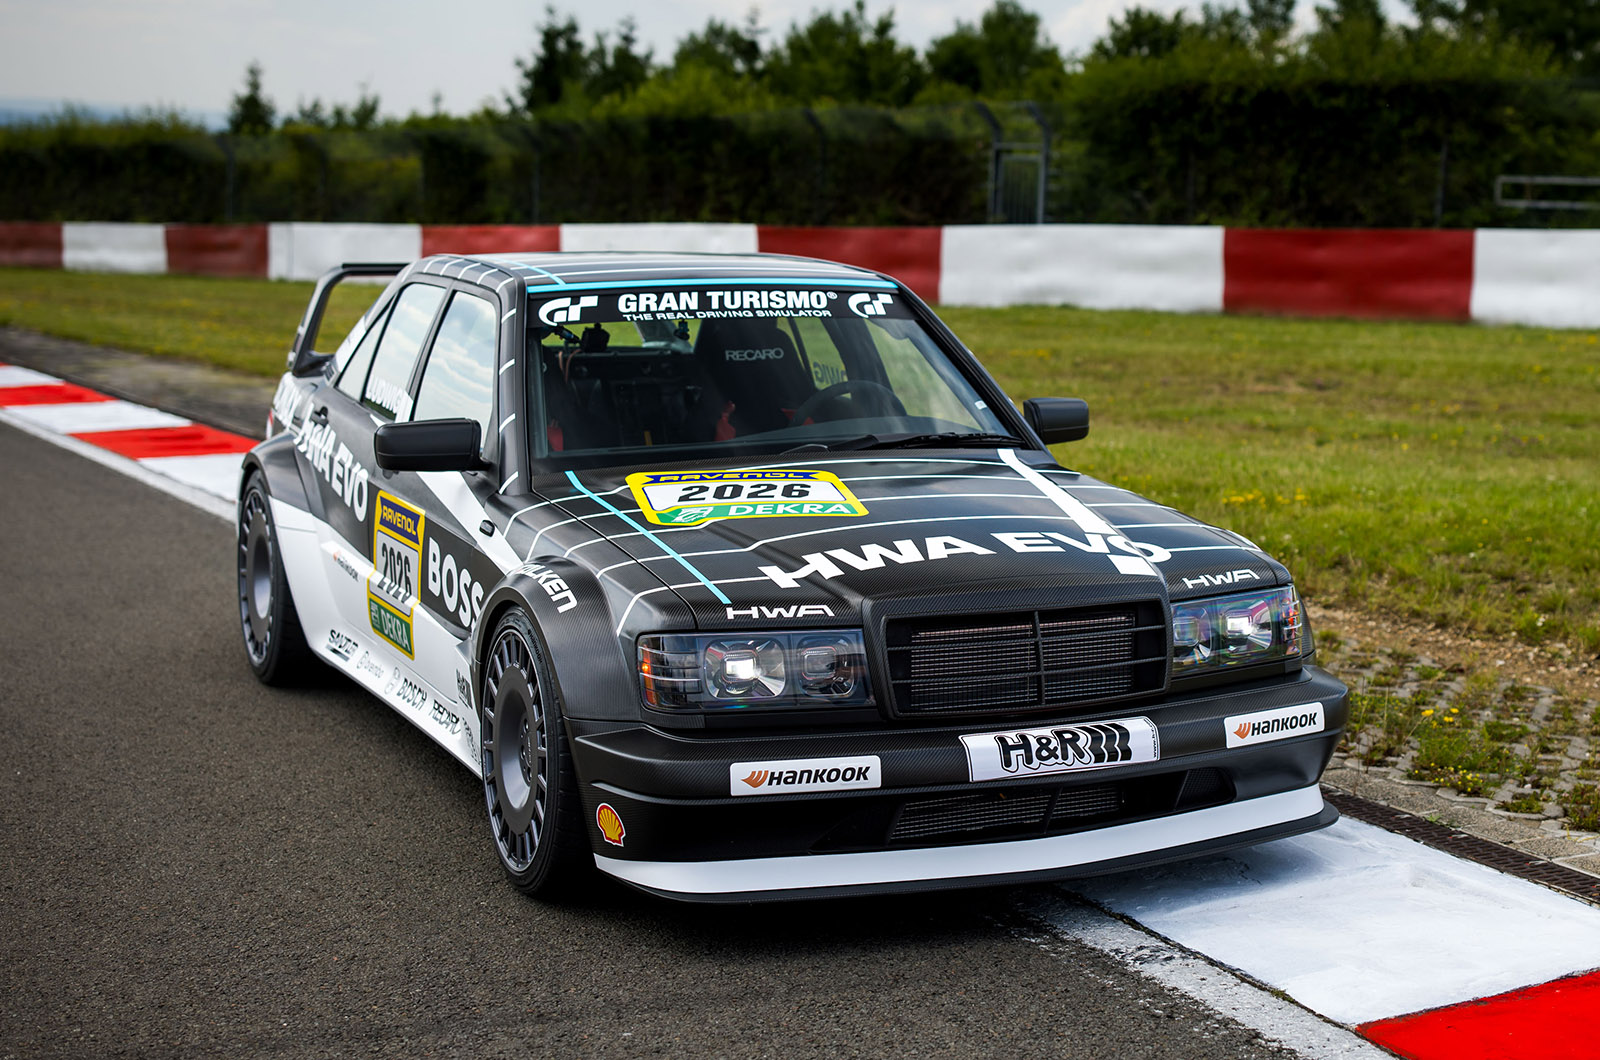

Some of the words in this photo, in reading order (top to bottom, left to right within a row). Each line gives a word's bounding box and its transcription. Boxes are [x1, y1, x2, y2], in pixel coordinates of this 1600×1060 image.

[618, 293, 699, 313] GRAN
[697, 310, 754, 319] DRIVING
[758, 309, 832, 317] SIMULATOR
[725, 348, 784, 361] RECARO
[331, 441, 369, 522] EVO
[659, 472, 804, 482] RAVENOL
[677, 483, 811, 503] 2026
[728, 503, 851, 516] DEKRA
[382, 505, 417, 536] RAVENOL
[757, 535, 998, 588] HWA
[989, 531, 1172, 566] EVO
[377, 542, 412, 603] 2026
[1182, 568, 1261, 589] HWA
[726, 605, 835, 620] HWA
[380, 608, 411, 652] DEKRA
[397, 677, 428, 712] BOSCH
[998, 729, 1093, 773] H&R
